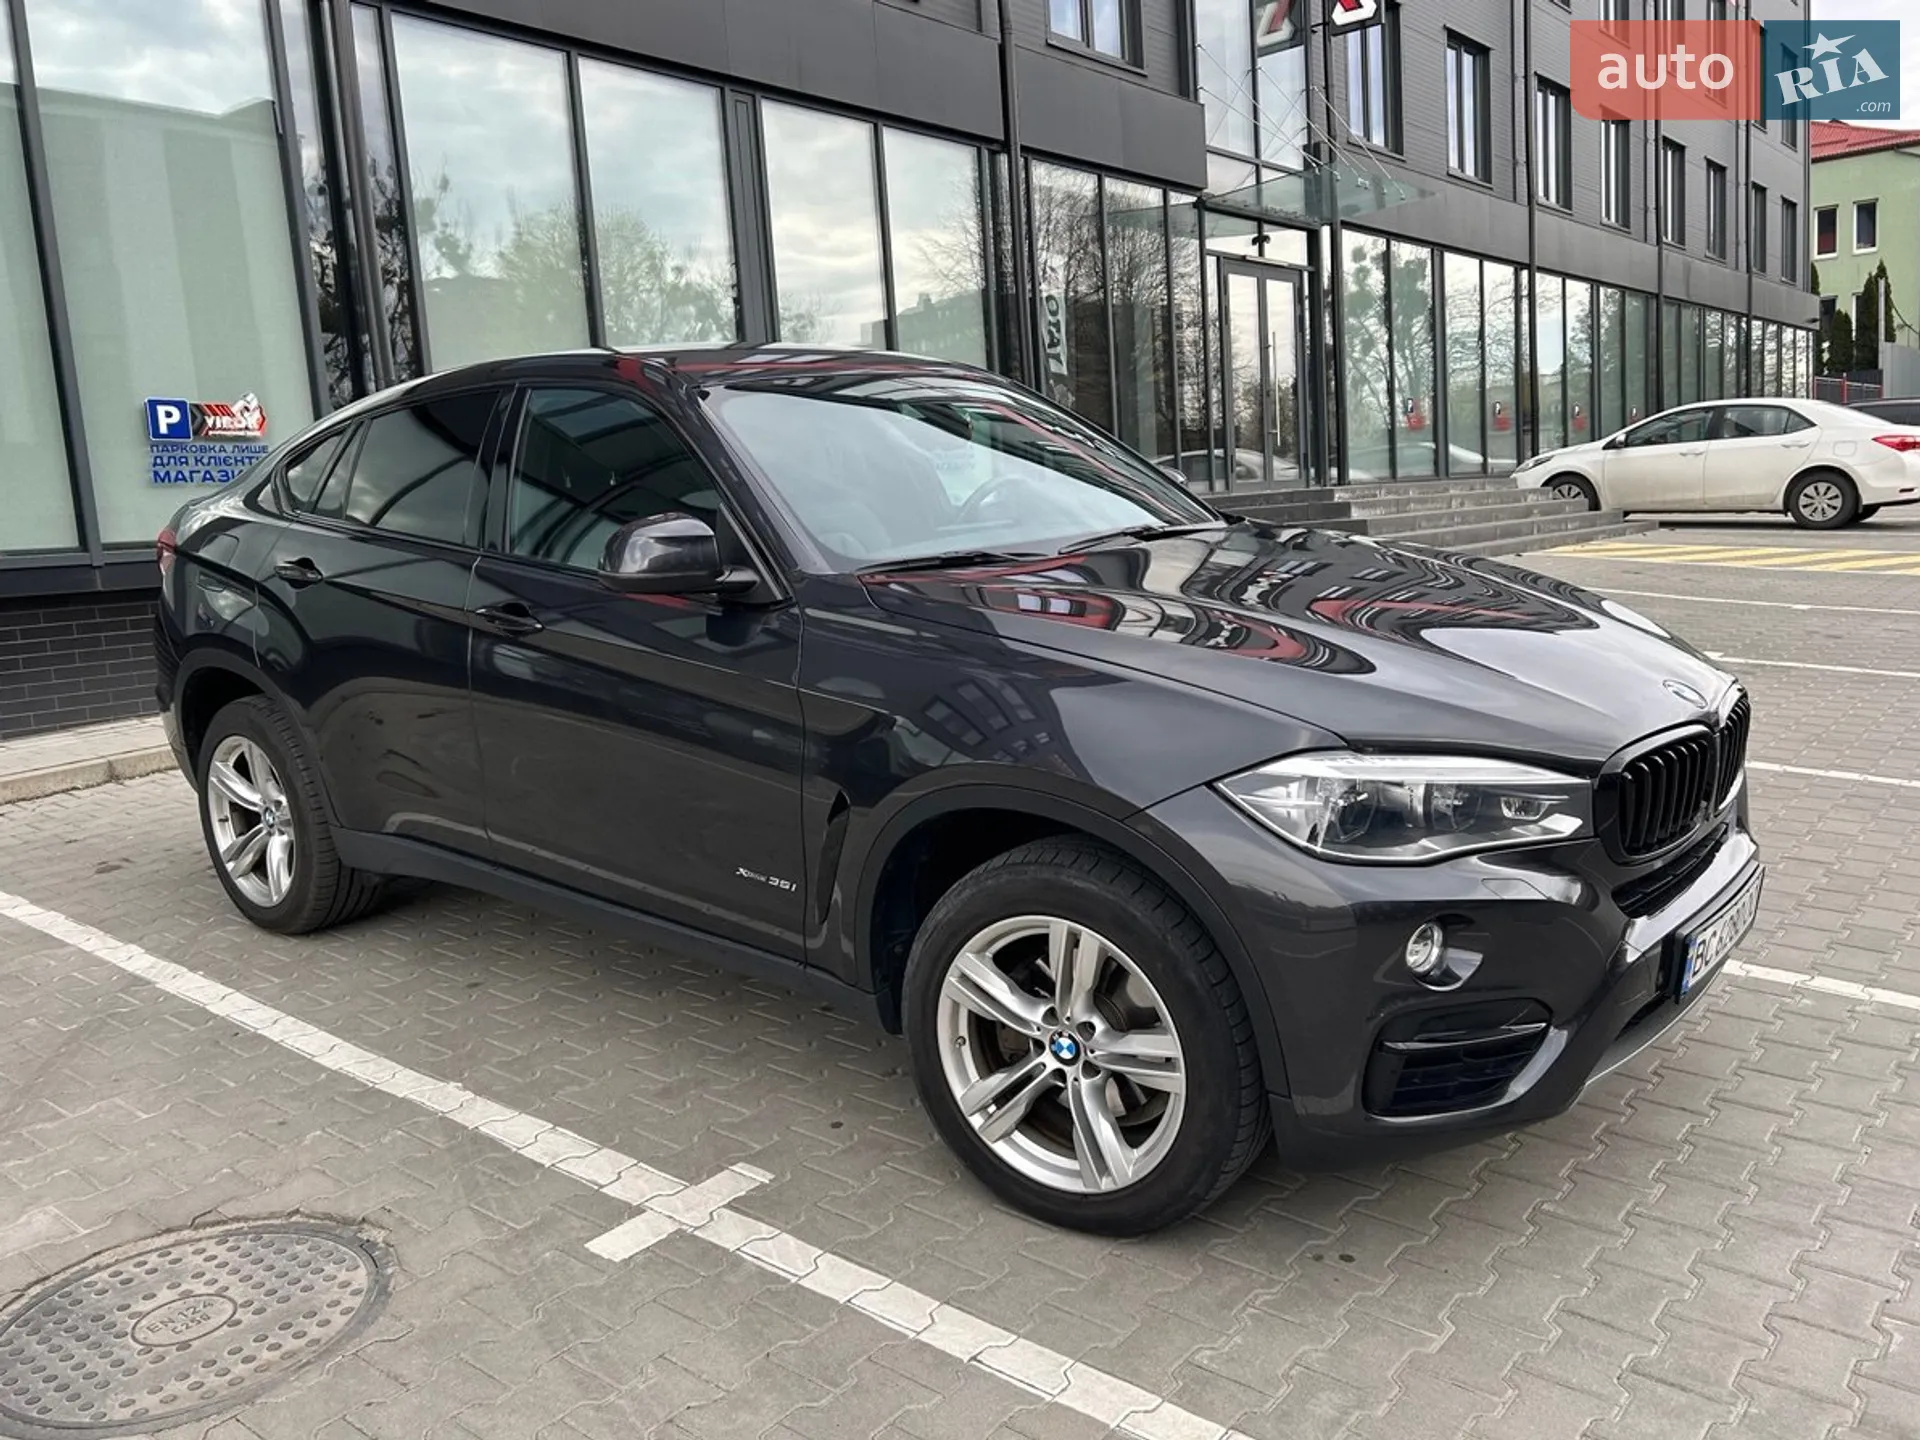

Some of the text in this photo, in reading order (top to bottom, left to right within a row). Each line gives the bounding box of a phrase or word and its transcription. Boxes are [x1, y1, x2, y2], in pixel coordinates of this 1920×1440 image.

[156, 404, 181, 435] P
[150, 444, 269, 454] ПАРКОВКА ЛИШЕ
[152, 456, 259, 468] ДЛЯ КЛІЄНТ
[146, 1317, 175, 1333] EN
